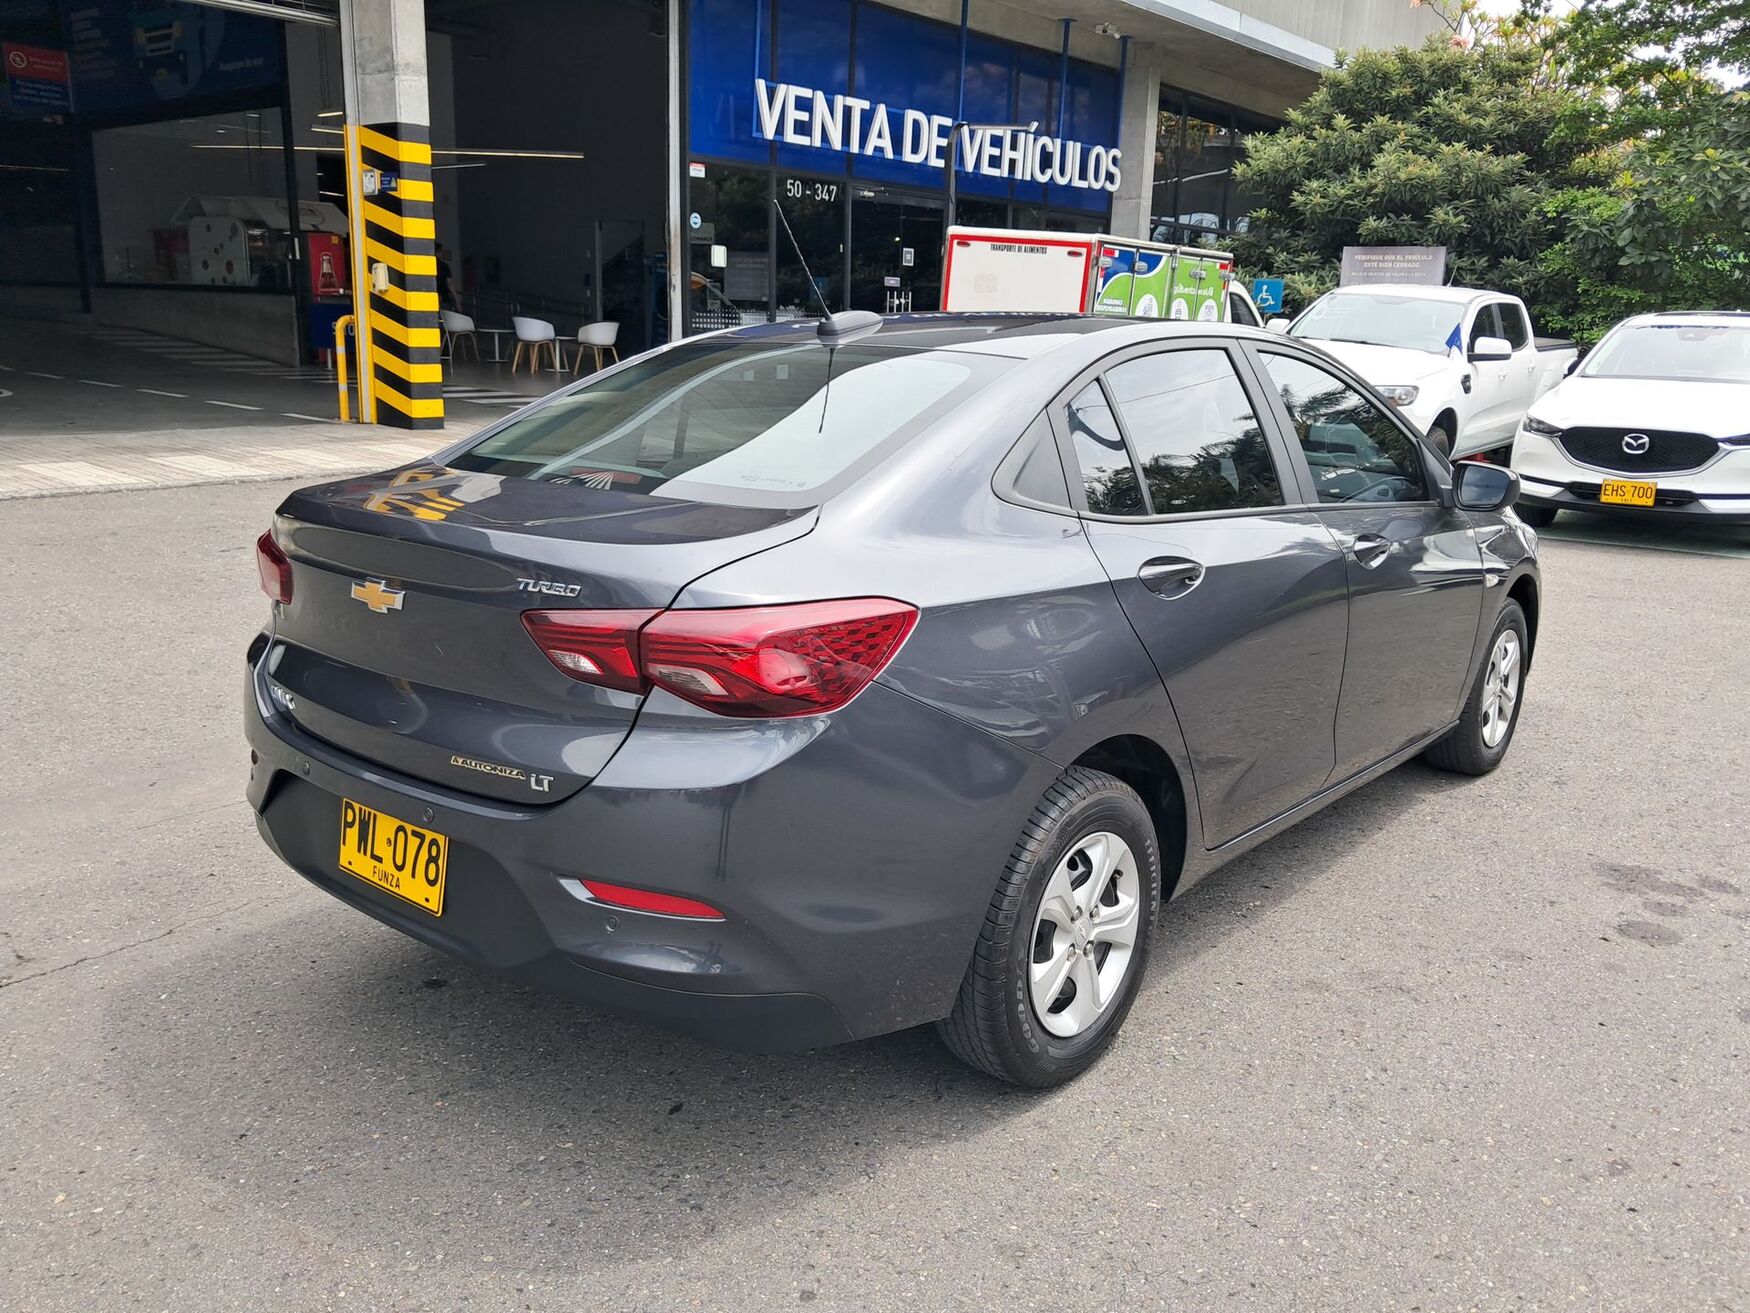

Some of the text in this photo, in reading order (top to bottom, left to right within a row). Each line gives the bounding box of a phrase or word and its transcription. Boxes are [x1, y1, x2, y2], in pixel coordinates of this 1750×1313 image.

[755, 78, 1123, 193] VENTA DE VEHÍCULOS
[786, 179, 802, 198] 50
[814, 183, 837, 202] 347
[1603, 483, 1653, 499] EHS 700
[516, 577, 581, 598] TURBO
[460, 758, 526, 779] AUTONIZA
[530, 773, 554, 792] LT
[342, 801, 442, 888] PWL 078
[372, 865, 401, 891] FUNZA
